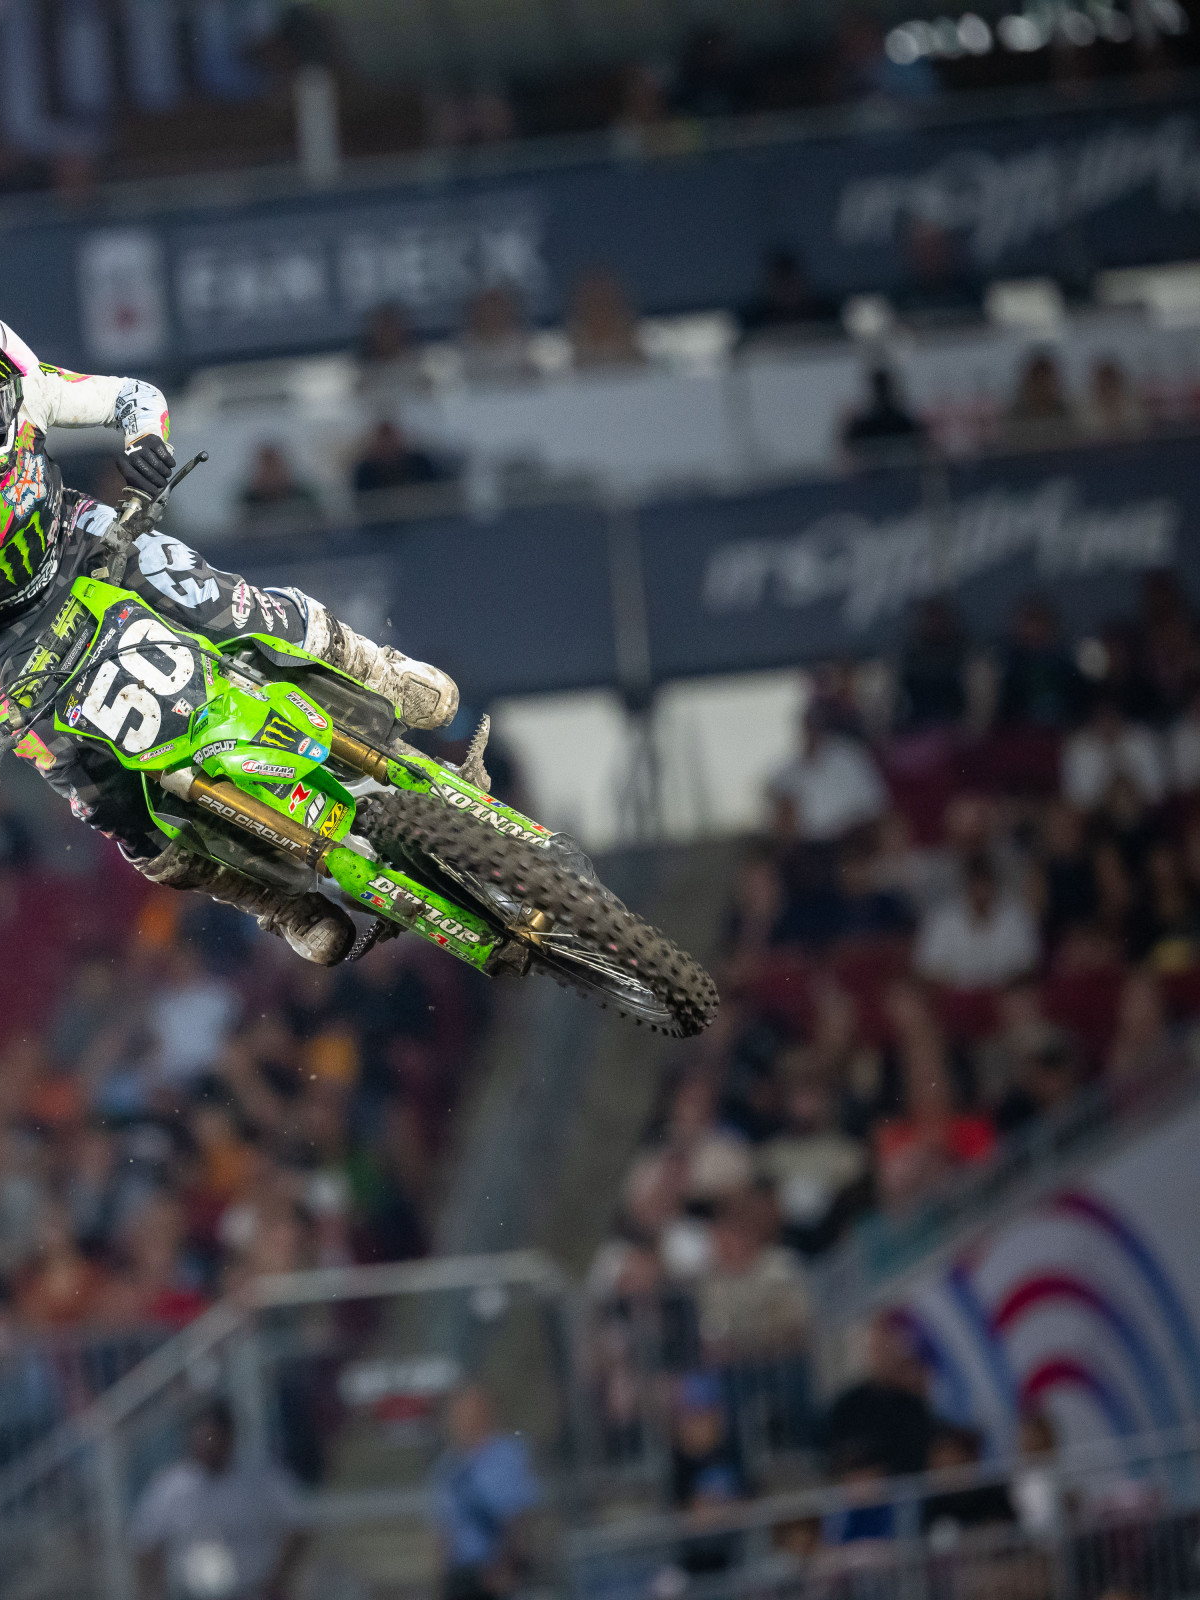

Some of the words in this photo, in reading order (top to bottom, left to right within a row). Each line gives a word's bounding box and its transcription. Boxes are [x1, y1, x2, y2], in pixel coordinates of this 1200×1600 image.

[81, 618, 195, 754] 50
[202, 740, 237, 759] CIRCUIT
[255, 762, 295, 775] MAXIMA
[198, 794, 237, 820] PRO
[234, 811, 302, 852] CIRCUIT
